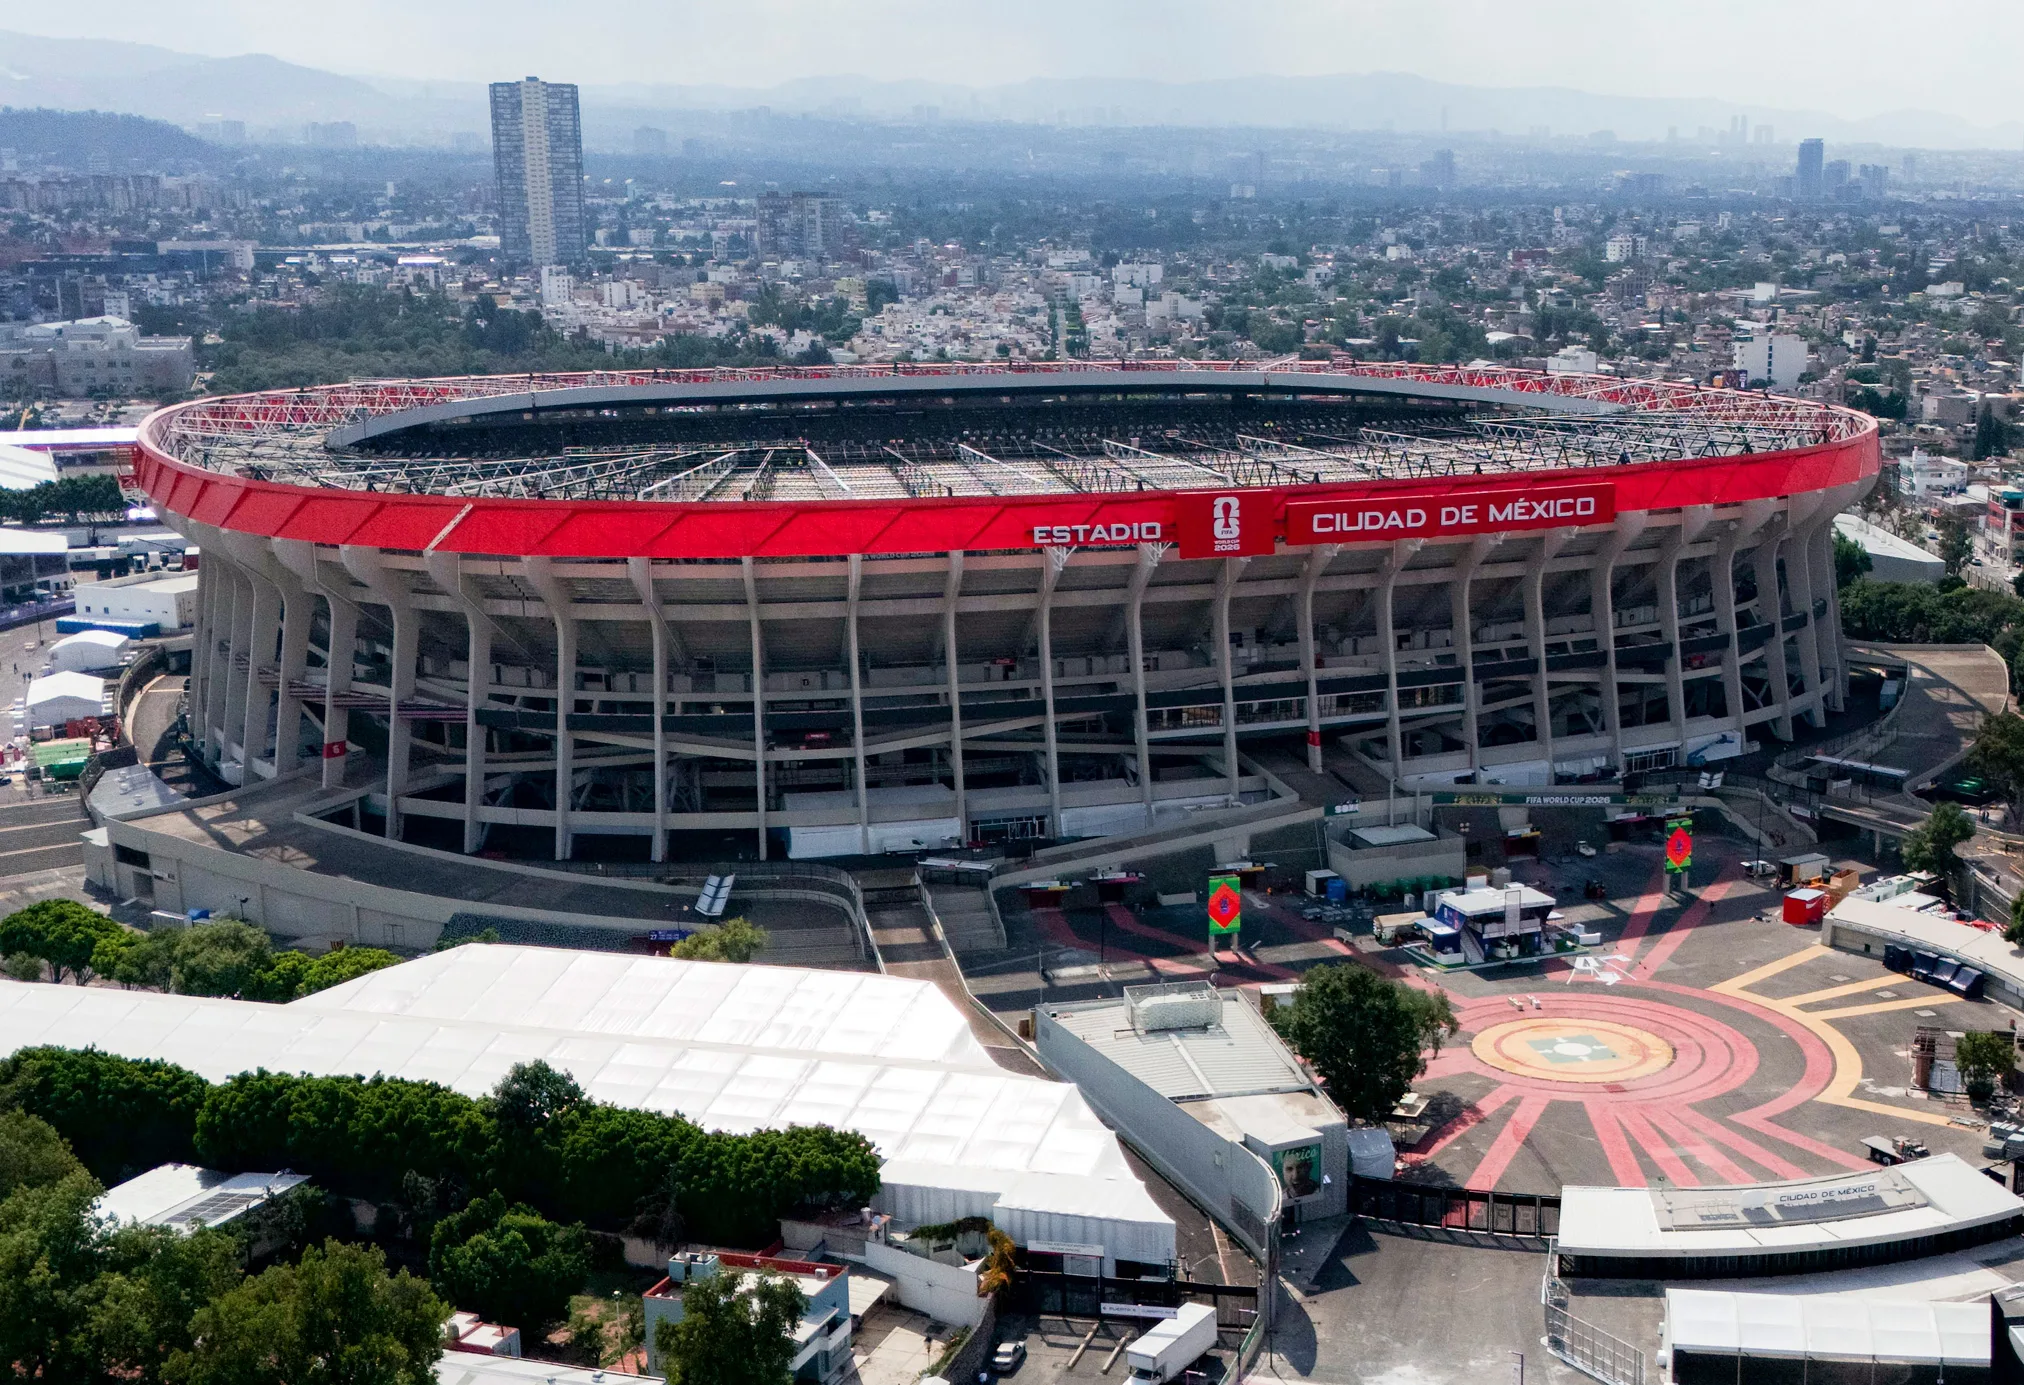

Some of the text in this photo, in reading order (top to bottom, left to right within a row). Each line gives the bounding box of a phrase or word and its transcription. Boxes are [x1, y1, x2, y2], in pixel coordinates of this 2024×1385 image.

[1312, 497, 1596, 533] CIUDAD DE MÉXICO
[1033, 522, 1161, 544] ESTADIO
[1525, 796, 1611, 804] FIFA WORLD CUP 2026
[1780, 1193, 1817, 1202] CIUDAD
[1838, 1185, 1875, 1196] MÉXICO
